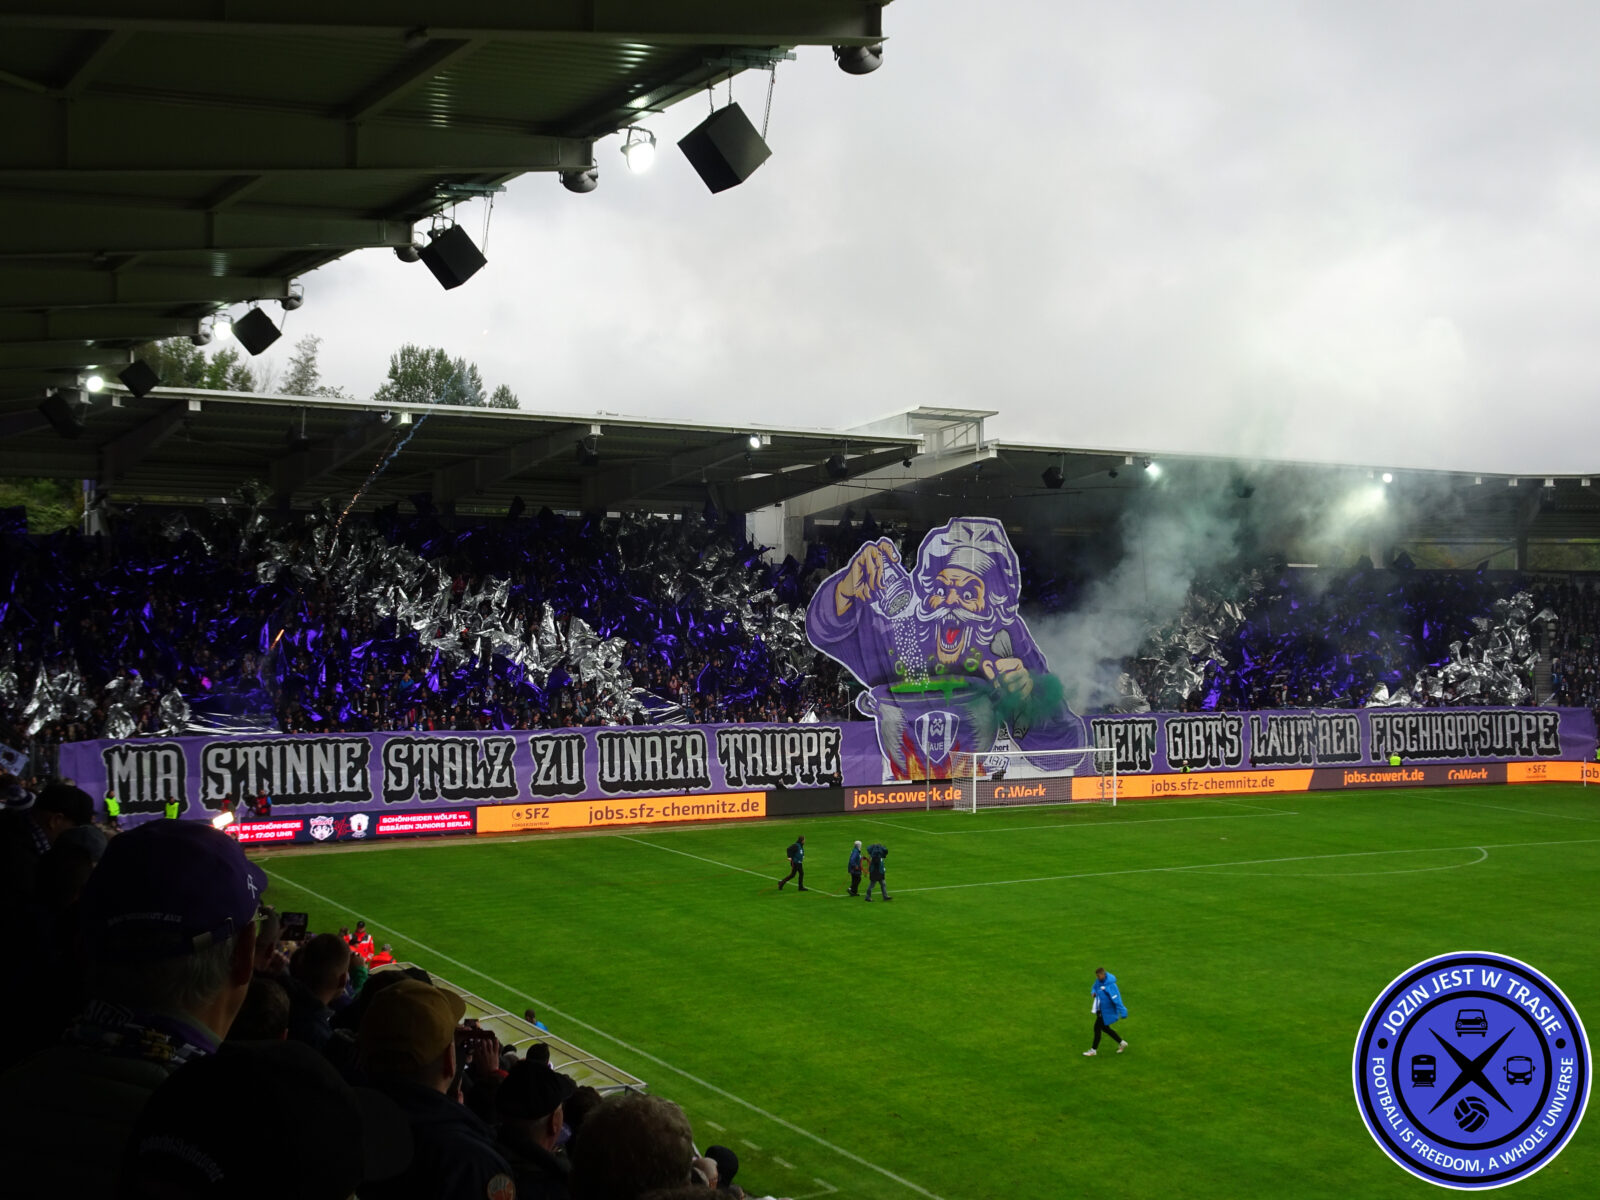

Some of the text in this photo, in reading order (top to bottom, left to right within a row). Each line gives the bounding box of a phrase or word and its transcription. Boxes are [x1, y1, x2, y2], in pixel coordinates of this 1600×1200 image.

[929, 742, 944, 751] AUE
[385, 739, 516, 798] STOLZ
[532, 736, 583, 791] ZU
[718, 729, 839, 784] TRUPPE
[1533, 764, 1547, 774] SFZ
[1343, 769, 1425, 786] jobs.cowerk.de
[1106, 780, 1124, 789] SZ
[1151, 776, 1275, 795] jobs.sfz-chemnitz.de
[525, 807, 550, 820] SFZ
[588, 798, 760, 824] jobs.sfz-chemnitz.de
[382, 815, 433, 823] SCHÖNHEIDER
[434, 813, 458, 821] WÖLFE
[252, 822, 301, 831] SCHÖNHEIDE
[379, 820, 471, 832] EISBÄREN JUNIORS BERLIN
